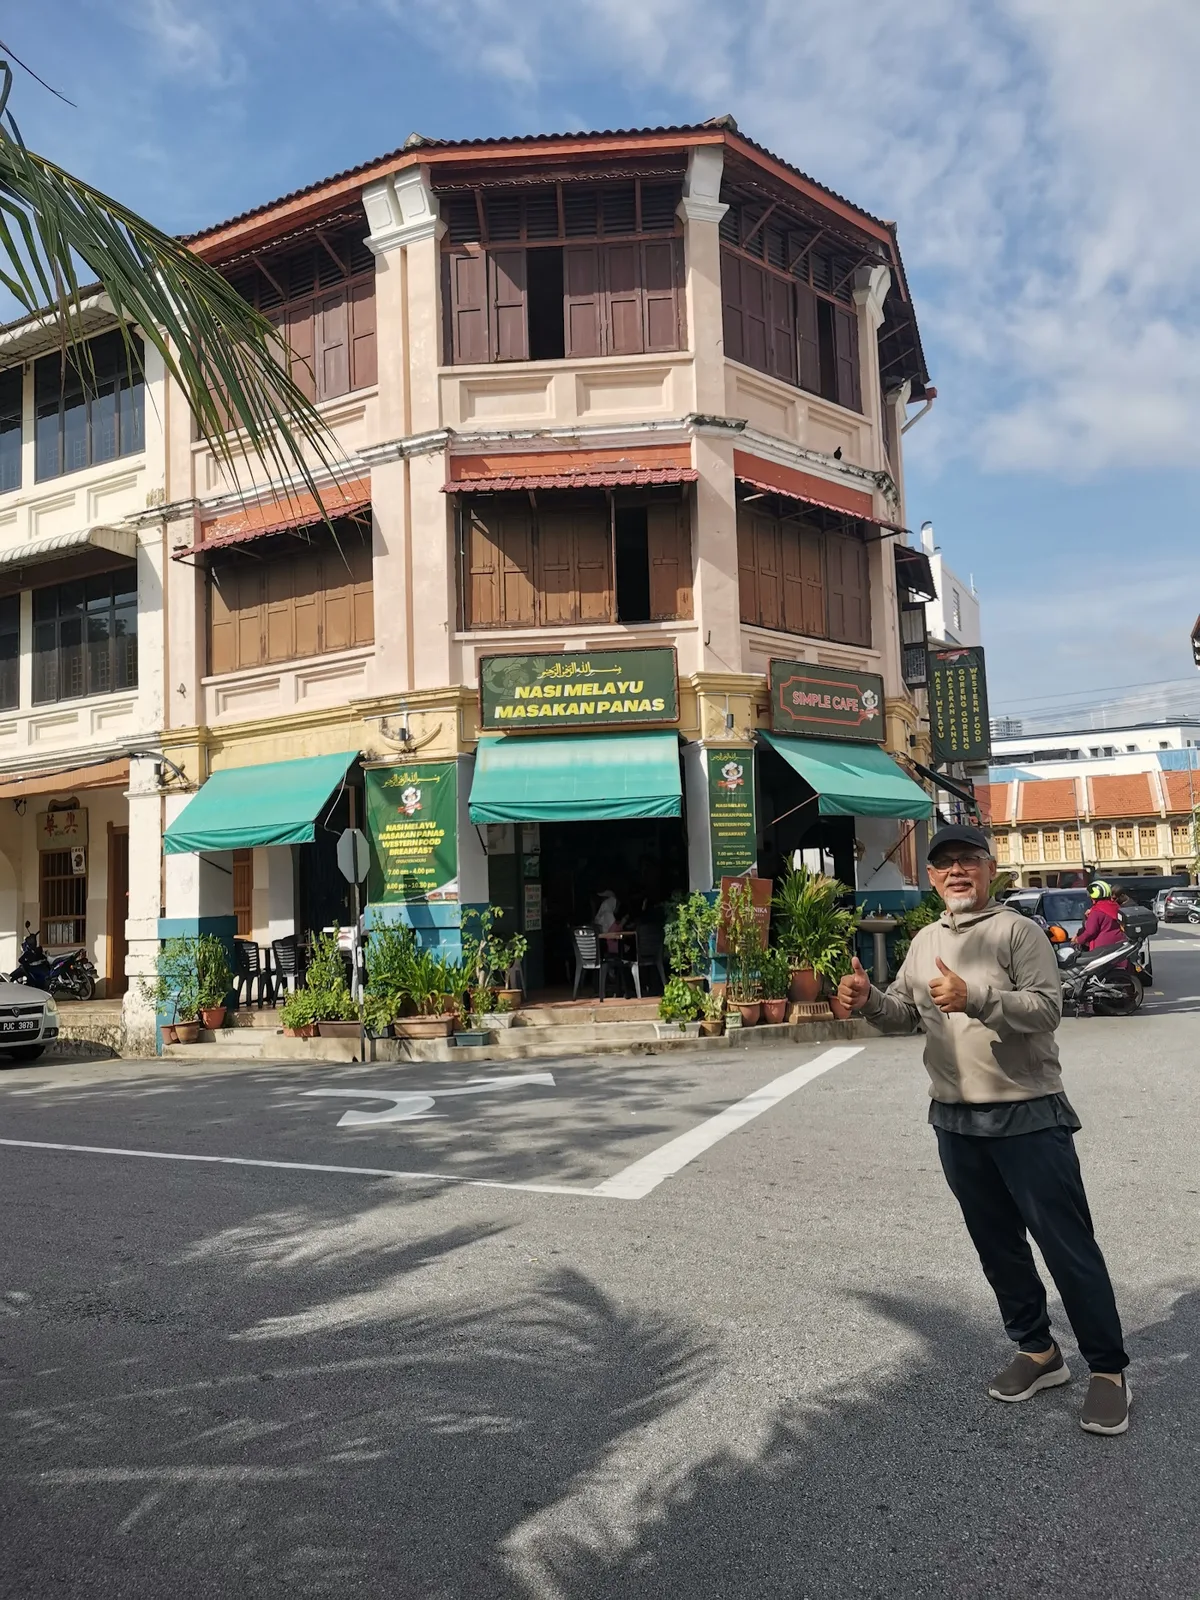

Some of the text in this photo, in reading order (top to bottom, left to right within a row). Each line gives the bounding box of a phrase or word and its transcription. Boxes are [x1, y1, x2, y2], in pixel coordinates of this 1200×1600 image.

[514, 680, 644, 699] NASI MELAYU
[946, 670, 956, 714] MASAKAN
[970, 668, 980, 712] WESTERN
[494, 698, 665, 719] MASAKAN PANAS
[792, 690, 859, 712] SIMPLE CAFE
[958, 668, 970, 750] GORENG GORENG
[936, 700, 944, 738] MELAYU
[378, 829, 445, 840] MASAKAN PANAS
[404, 821, 436, 830] MELAYU
[382, 838, 442, 848] WESTERN FOOD
[389, 847, 434, 856] BREAKFAST
